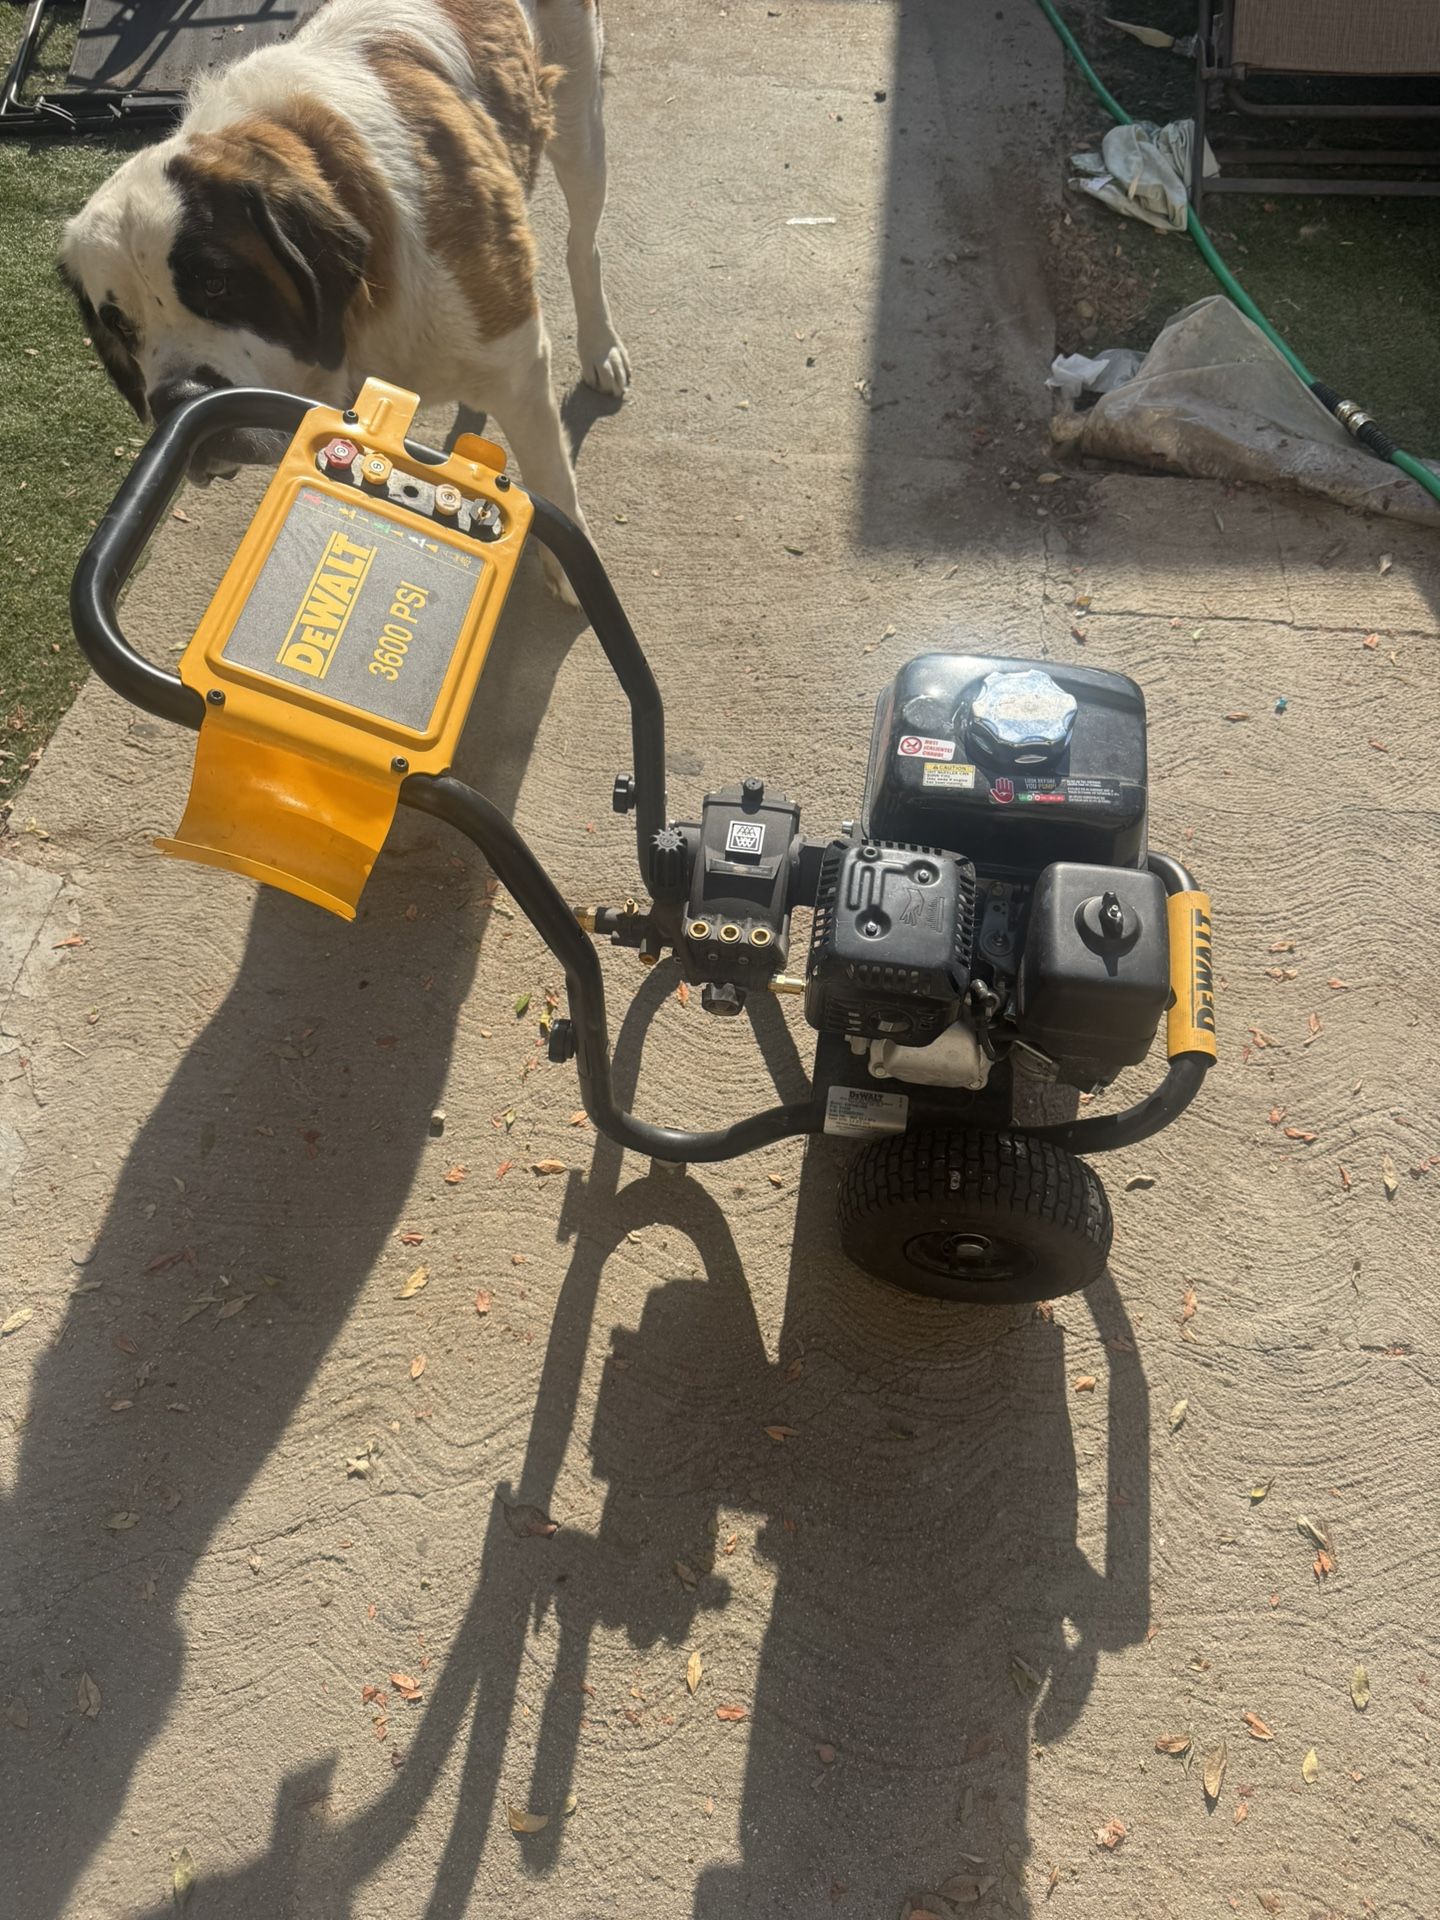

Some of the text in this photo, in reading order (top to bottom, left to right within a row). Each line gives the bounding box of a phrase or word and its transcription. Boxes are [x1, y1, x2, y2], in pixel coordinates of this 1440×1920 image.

[281, 531, 372, 678] DEWALT
[389, 580, 430, 624] PSI
[368, 623, 414, 682] 3600
[1195, 908, 1216, 1034] DEWALT
